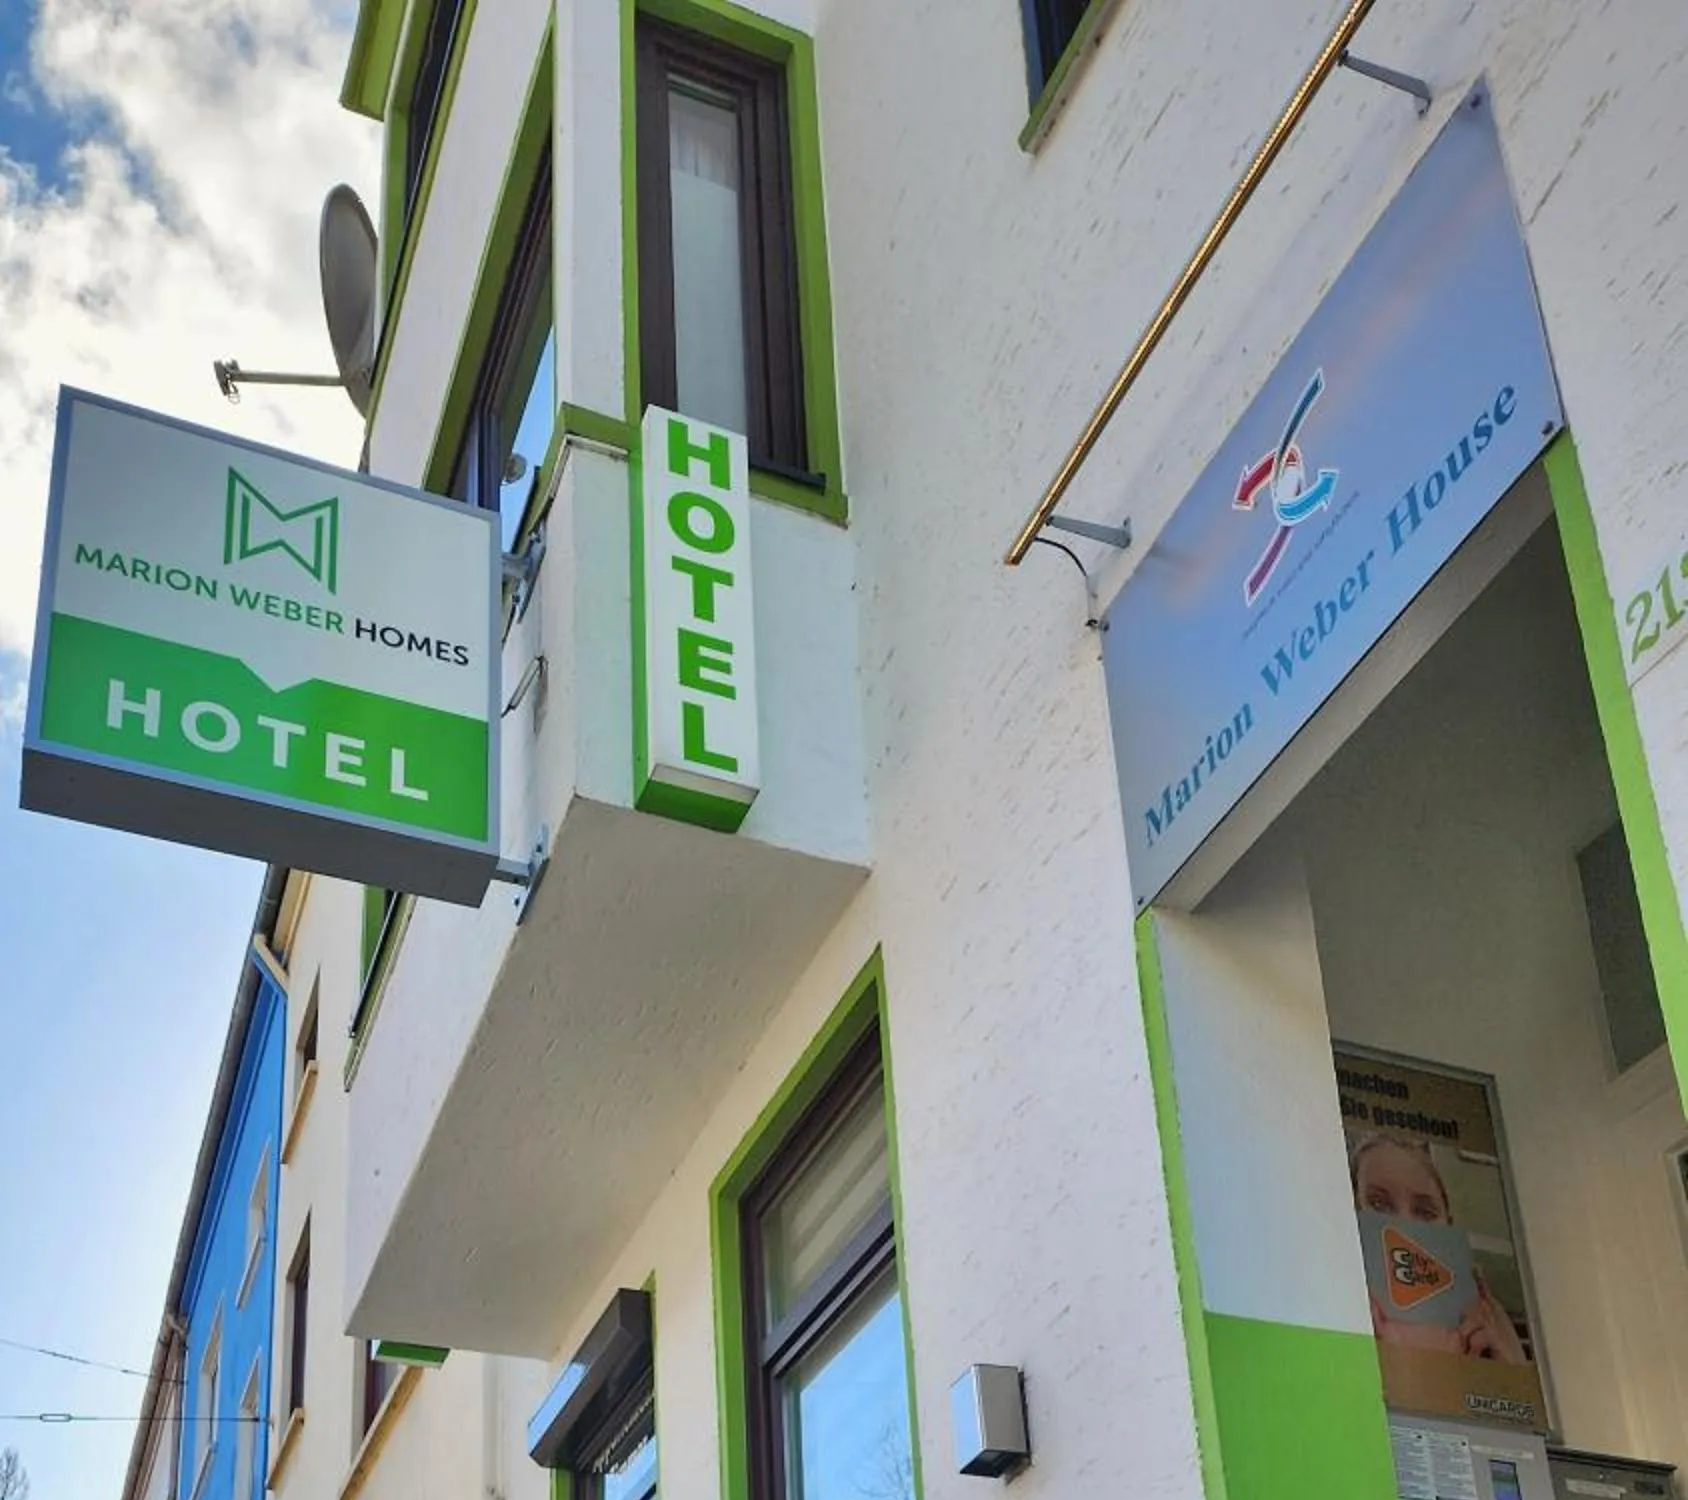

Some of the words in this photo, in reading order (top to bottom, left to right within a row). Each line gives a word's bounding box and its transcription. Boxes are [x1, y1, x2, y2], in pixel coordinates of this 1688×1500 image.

[74, 543, 218, 599] MARION
[229, 584, 345, 635] WEBER
[354, 617, 470, 667] HOMES
[667, 417, 738, 774] HOTEL
[1143, 701, 1254, 848] Marion
[1259, 549, 1376, 698] Weber
[1384, 383, 1518, 557] House
[106, 678, 430, 802] HOTEL
